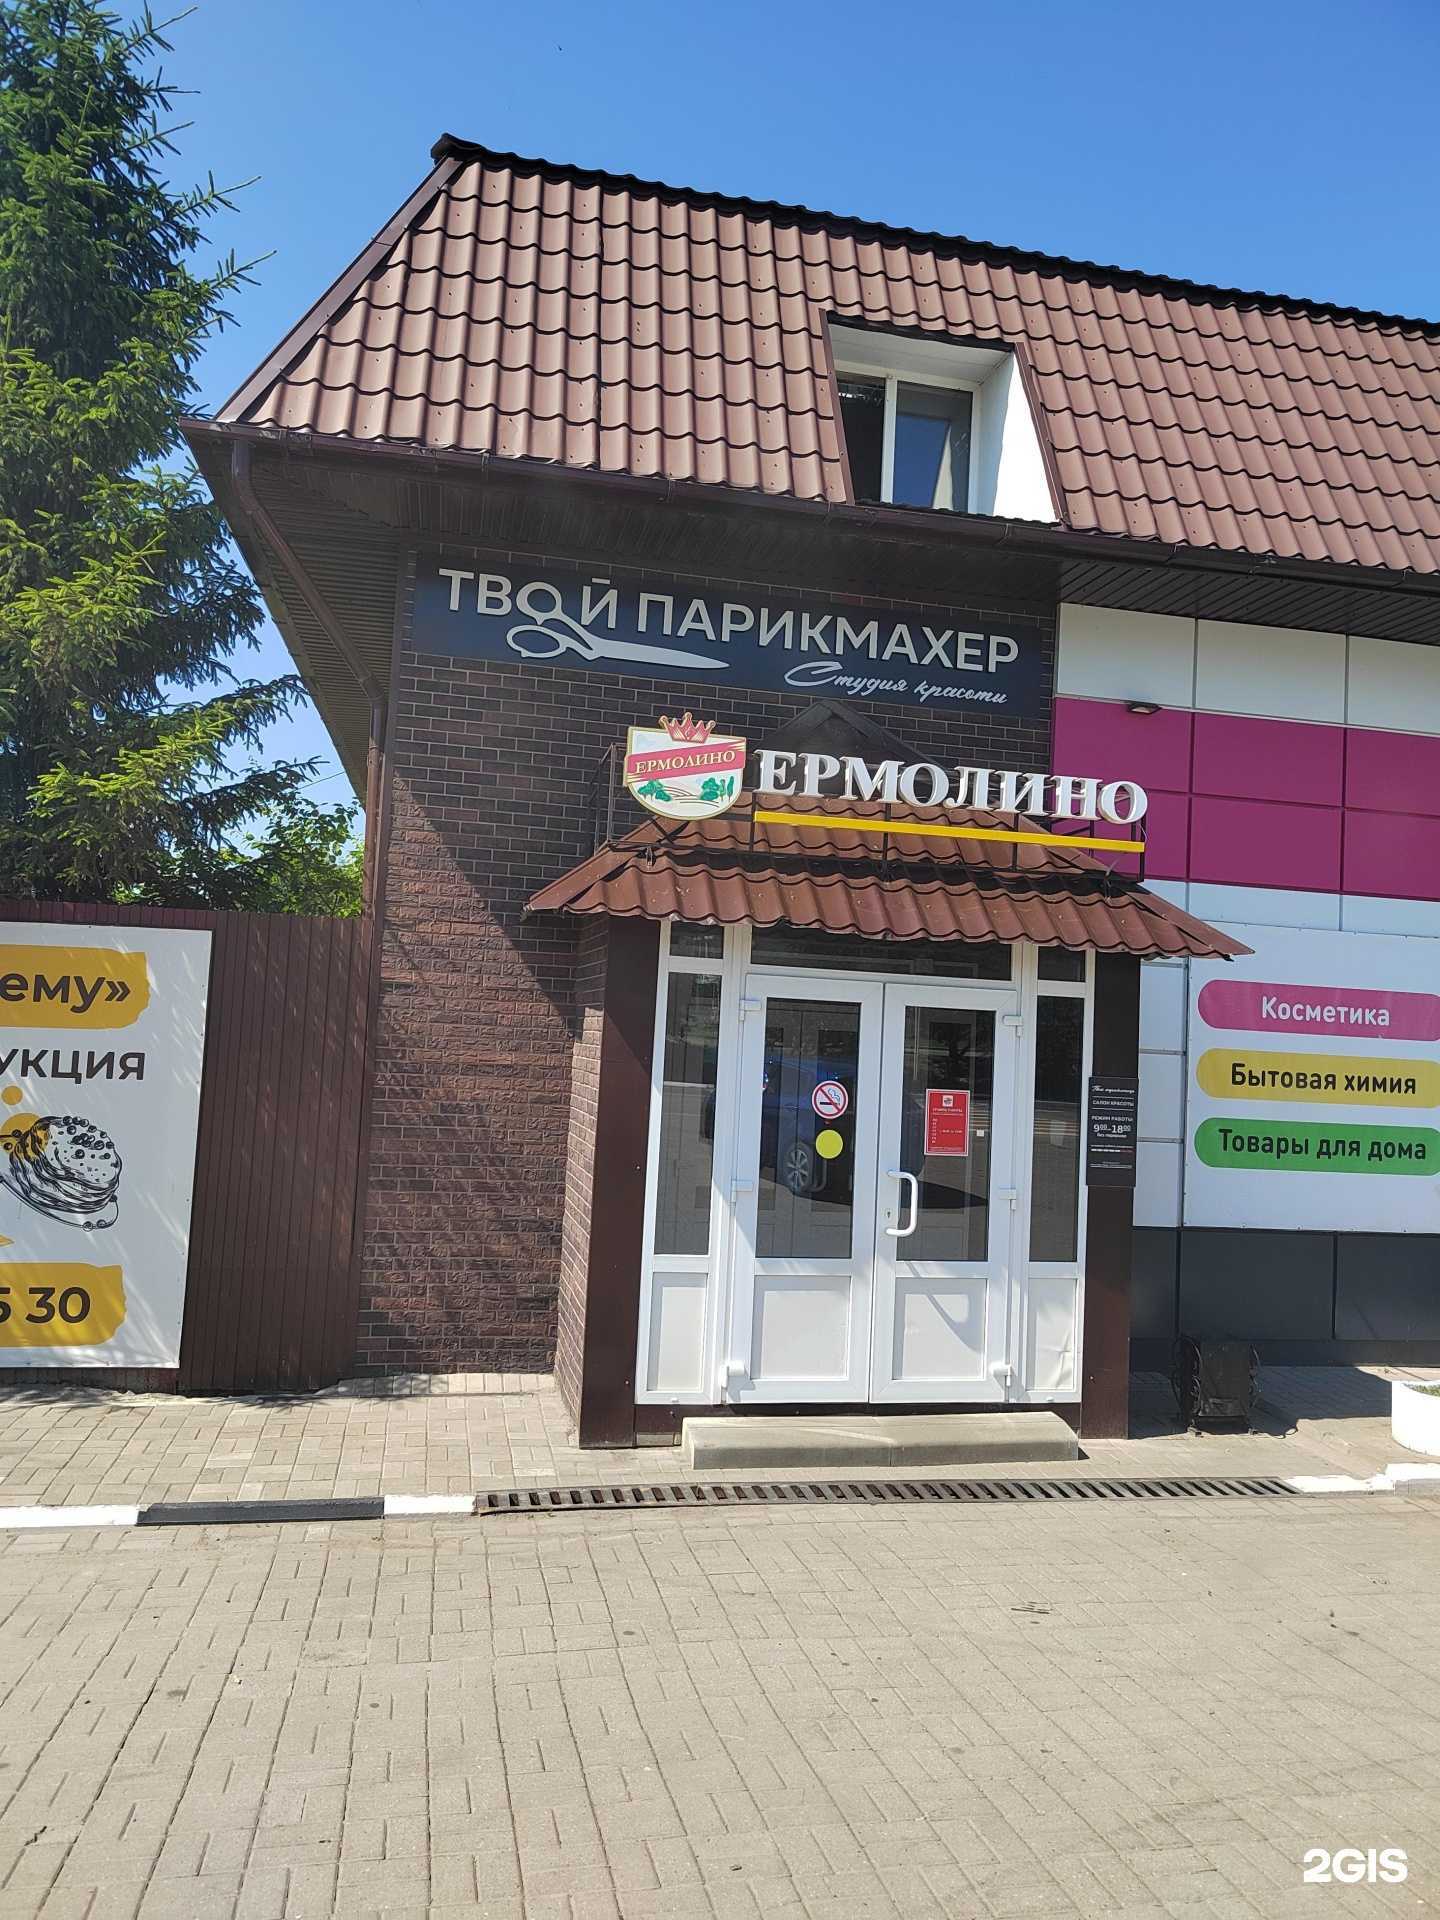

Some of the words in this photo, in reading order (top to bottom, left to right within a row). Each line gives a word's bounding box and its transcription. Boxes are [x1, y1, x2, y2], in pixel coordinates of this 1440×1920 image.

[438, 568, 618, 630] ТВОЙ
[637, 591, 1020, 674] ПАРИКМАХЕР
[783, 660, 908, 696] Студия
[634, 750, 736, 774] ЕРМОЛИНО
[752, 749, 1149, 825] ЕРМОЛИНО
[1261, 996, 1391, 1026] Косметика
[1230, 1062, 1338, 1091] Бытовая
[1343, 1073, 1417, 1095] химия
[1218, 1128, 1310, 1159] Товары
[1316, 1138, 1361, 1160] для
[1367, 1141, 1427, 1162] дома
[25, 1286, 91, 1324] 30
